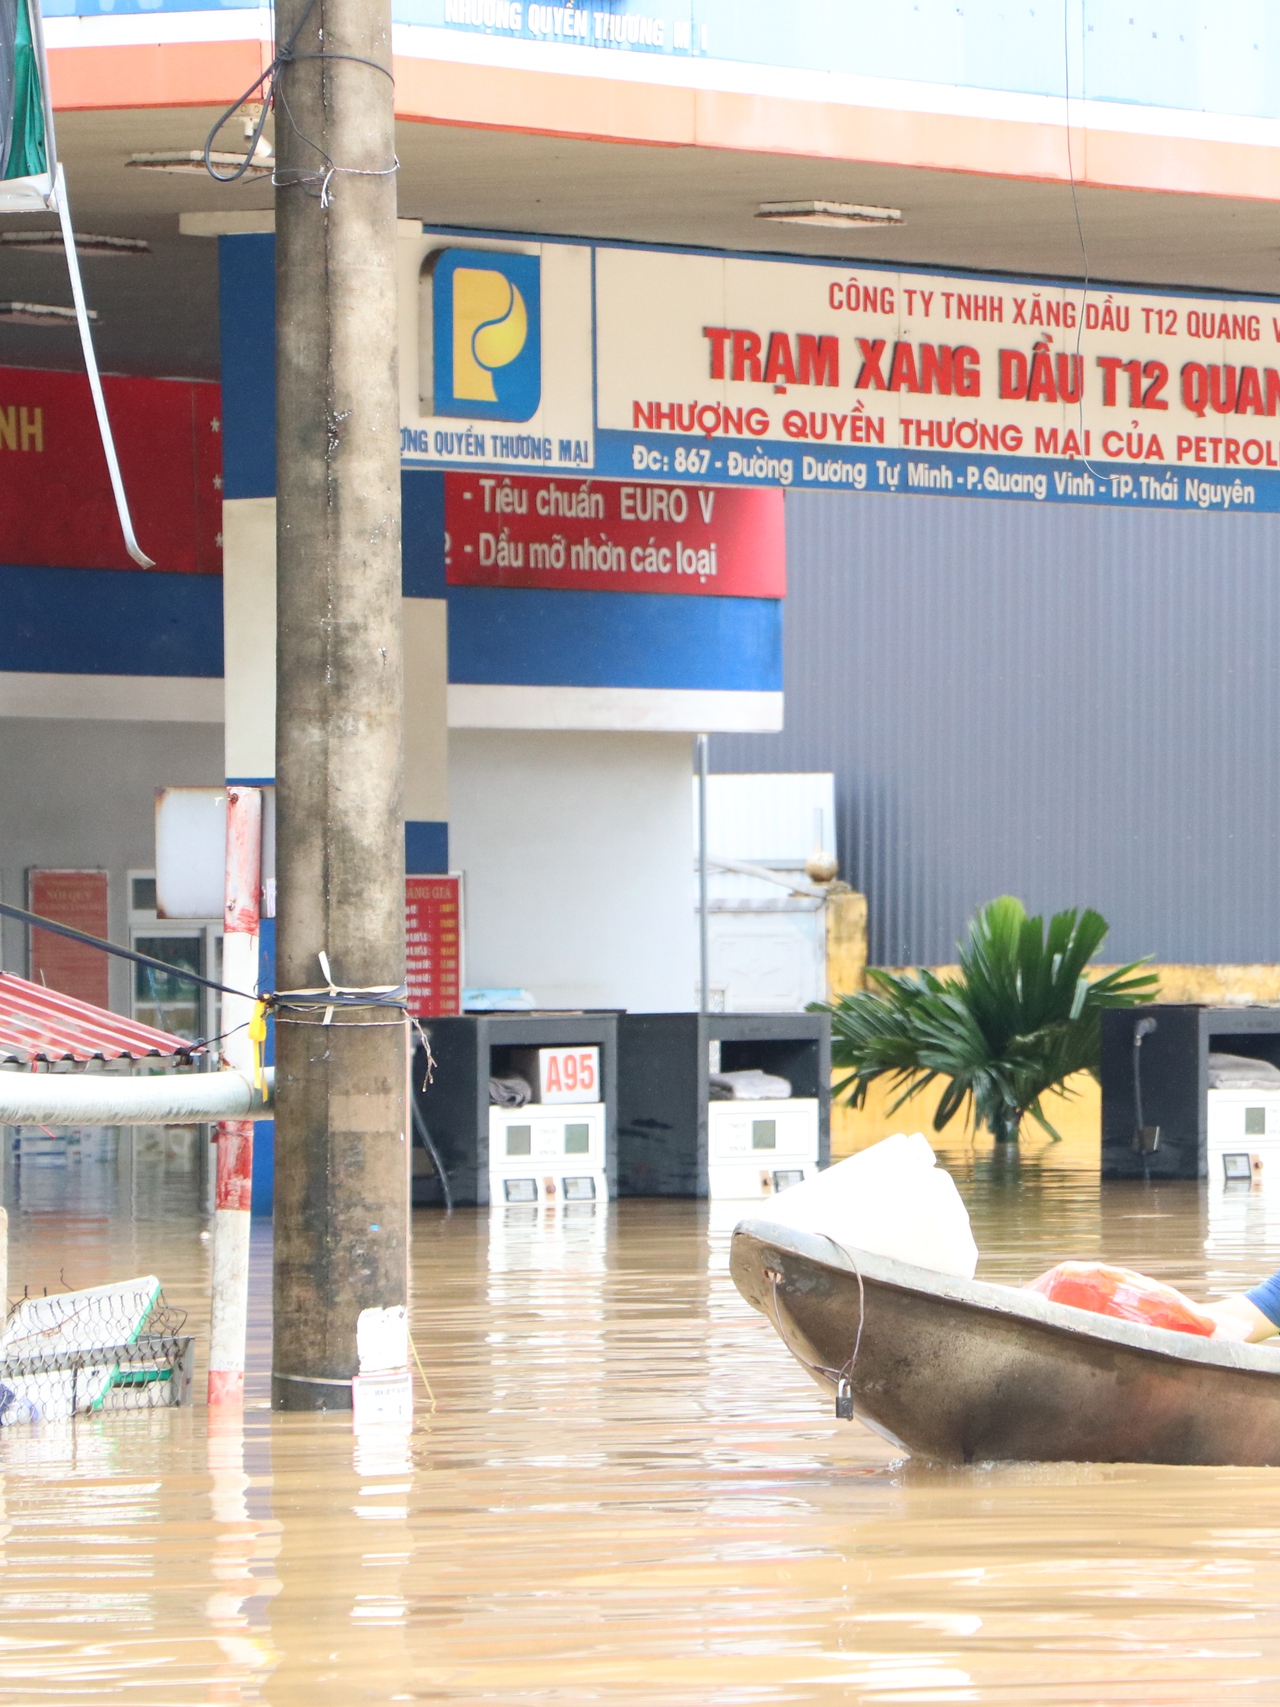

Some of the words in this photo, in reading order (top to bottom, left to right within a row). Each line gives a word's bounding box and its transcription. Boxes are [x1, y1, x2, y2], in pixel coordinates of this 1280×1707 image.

[444, 0, 522, 34] NHƯỢNG
[594, 11, 664, 47] THƯƠNG
[829, 277, 894, 315] CÔNG
[903, 290, 934, 318] TY
[942, 292, 1003, 323] TNHH
[1013, 293, 1076, 329] XĂNG
[1086, 294, 1130, 332] DẦU
[1142, 308, 1177, 336] T12
[1187, 311, 1260, 342] QUANG
[702, 326, 839, 395] TRẠM
[855, 337, 981, 398] XANG
[999, 332, 1084, 404] DẦU
[1097, 355, 1169, 410] T12
[490, 433, 552, 461] THƯƠNG
[558, 439, 588, 467] MẠI
[632, 401, 770, 441] NHƯỢNG
[782, 398, 885, 445] QUYỀN
[901, 417, 1023, 453] THƯƠNG
[1036, 425, 1091, 461] MẠI
[1102, 420, 1165, 462] CỦA
[479, 477, 529, 515] Tiêu
[620, 486, 689, 524] EURO
[698, 490, 716, 525] V
[632, 445, 669, 472] Đc:
[674, 448, 708, 475] 867
[727, 446, 793, 487] Đường
[802, 455, 866, 489] Dương
[876, 459, 901, 492] Tự
[908, 461, 953, 489] Minh
[966, 465, 1047, 500] P.Quang
[1053, 470, 1095, 497] Vinh
[1185, 477, 1256, 508] Nguyên
[479, 526, 525, 568] Dầu
[528, 533, 569, 570] mỡ
[571, 532, 627, 573] nhờn
[630, 536, 672, 574] các
[676, 540, 719, 584] loại
[545, 1052, 595, 1093] A95
